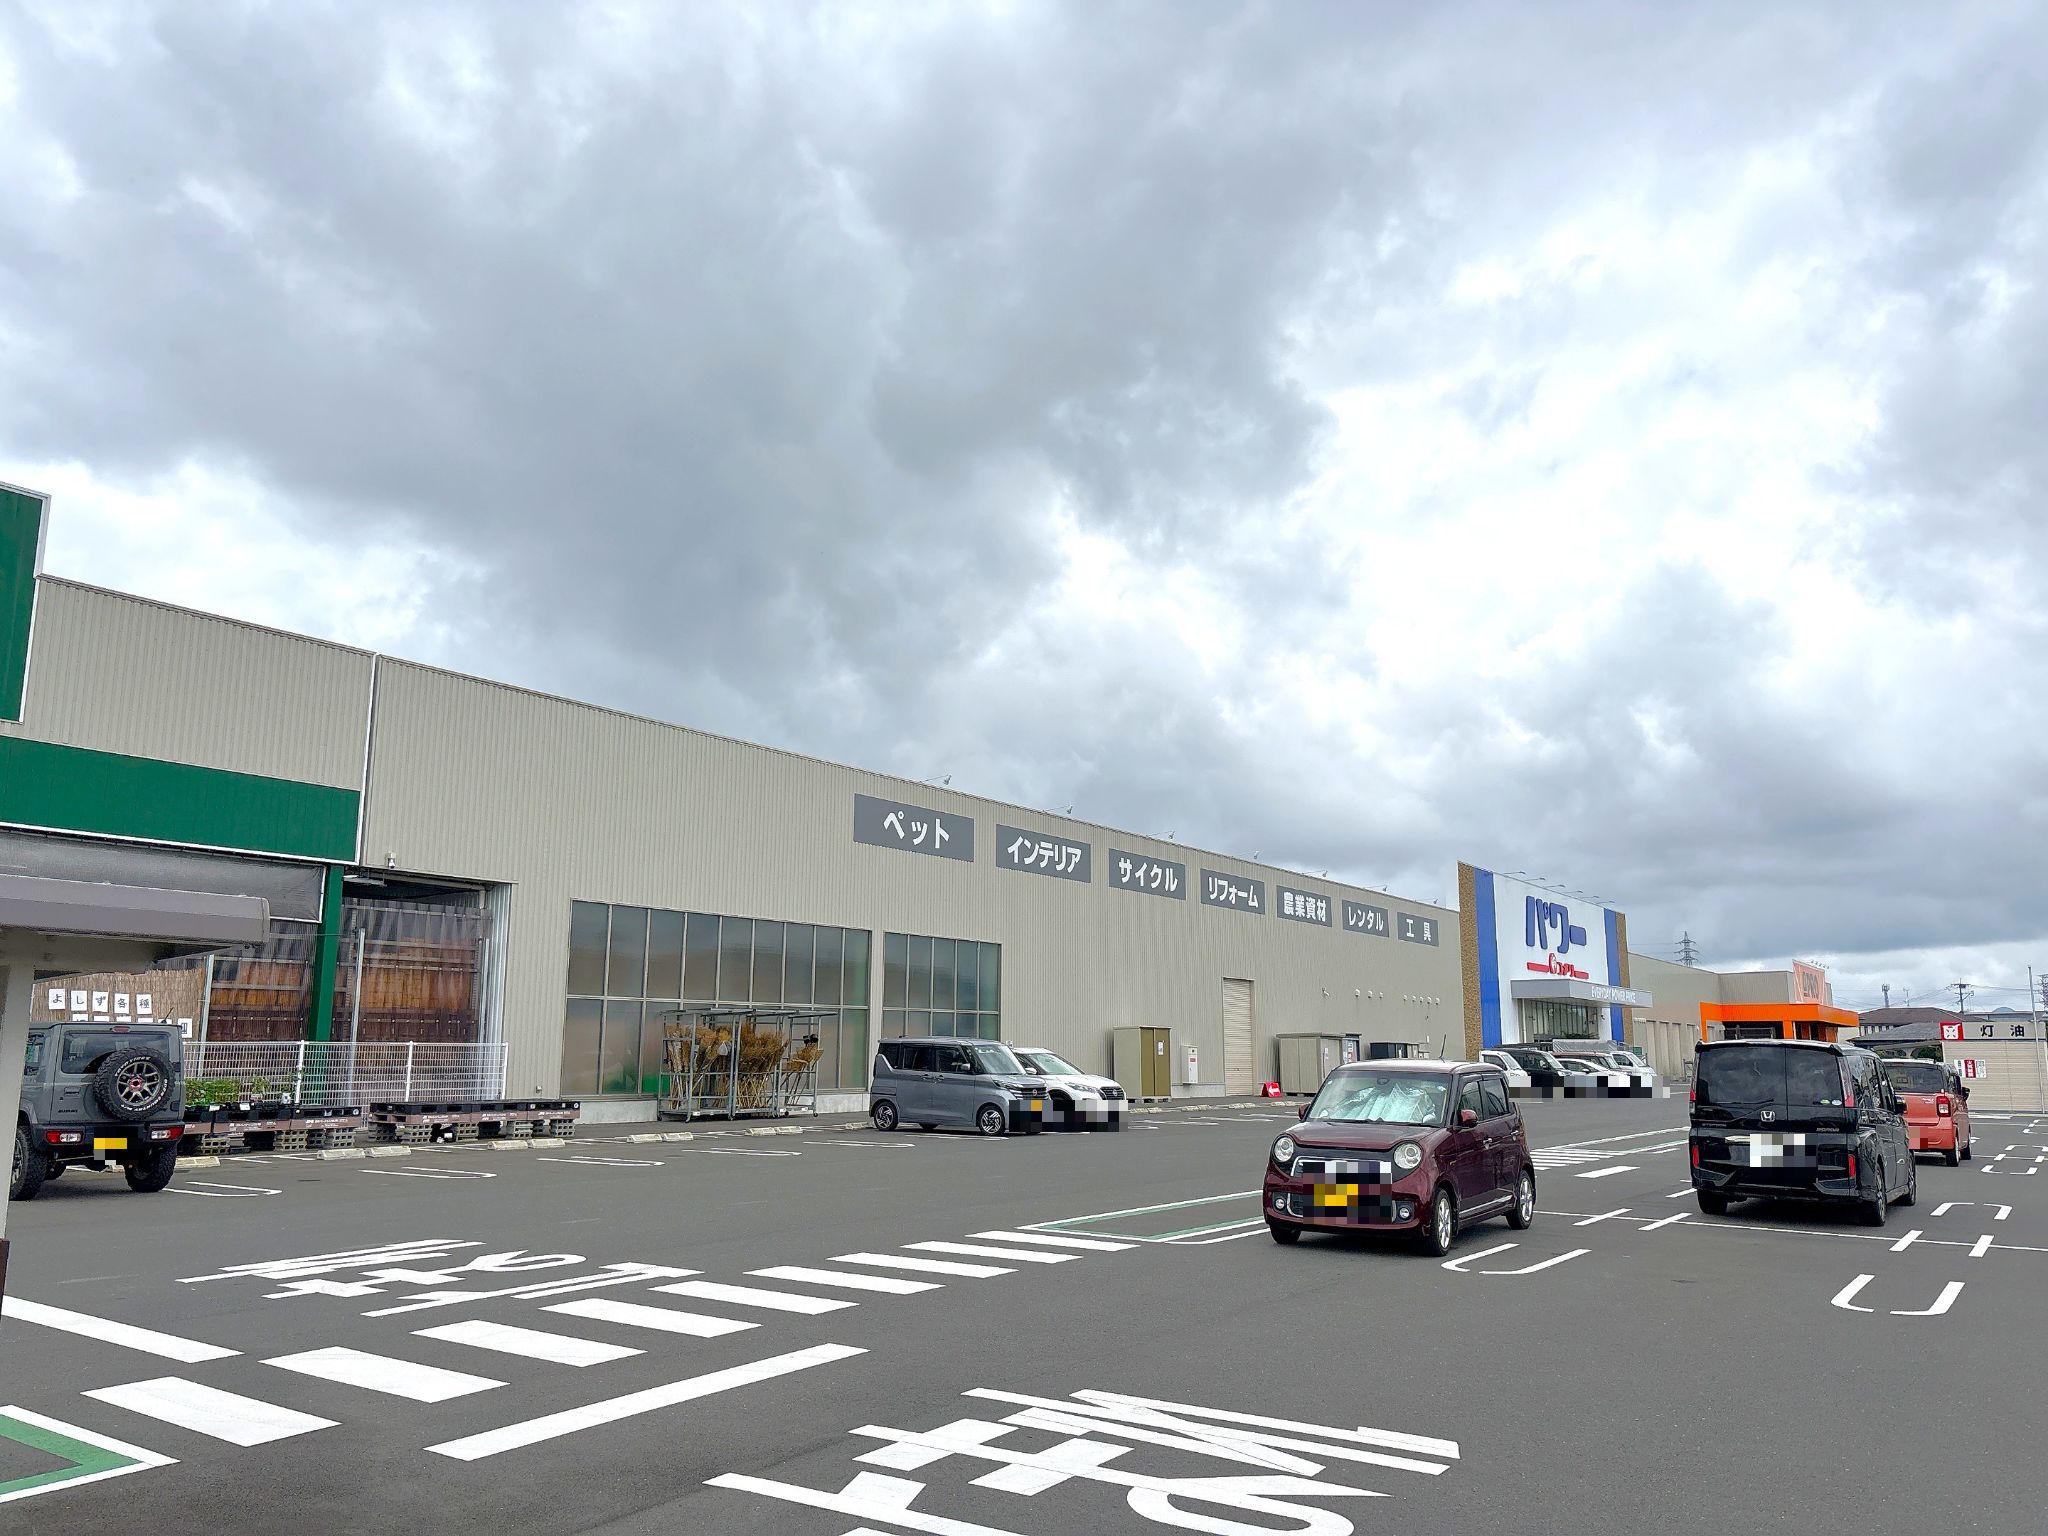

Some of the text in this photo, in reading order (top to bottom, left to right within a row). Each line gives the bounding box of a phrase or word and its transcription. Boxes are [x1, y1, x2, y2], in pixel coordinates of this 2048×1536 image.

[883, 810, 950, 849] ペット
[1007, 835, 1082, 874] インテリア
[1118, 857, 1178, 892] サイクル
[1208, 876, 1259, 909] リフォーム
[1283, 891, 1327, 923] 農業資材
[1347, 906, 1384, 932] レンタル
[1406, 918, 1432, 942] 工具
[1525, 895, 1587, 955] パワー
[52, 993, 150, 1009] よしず各種
[1980, 1024, 2025, 1038] 灯油
